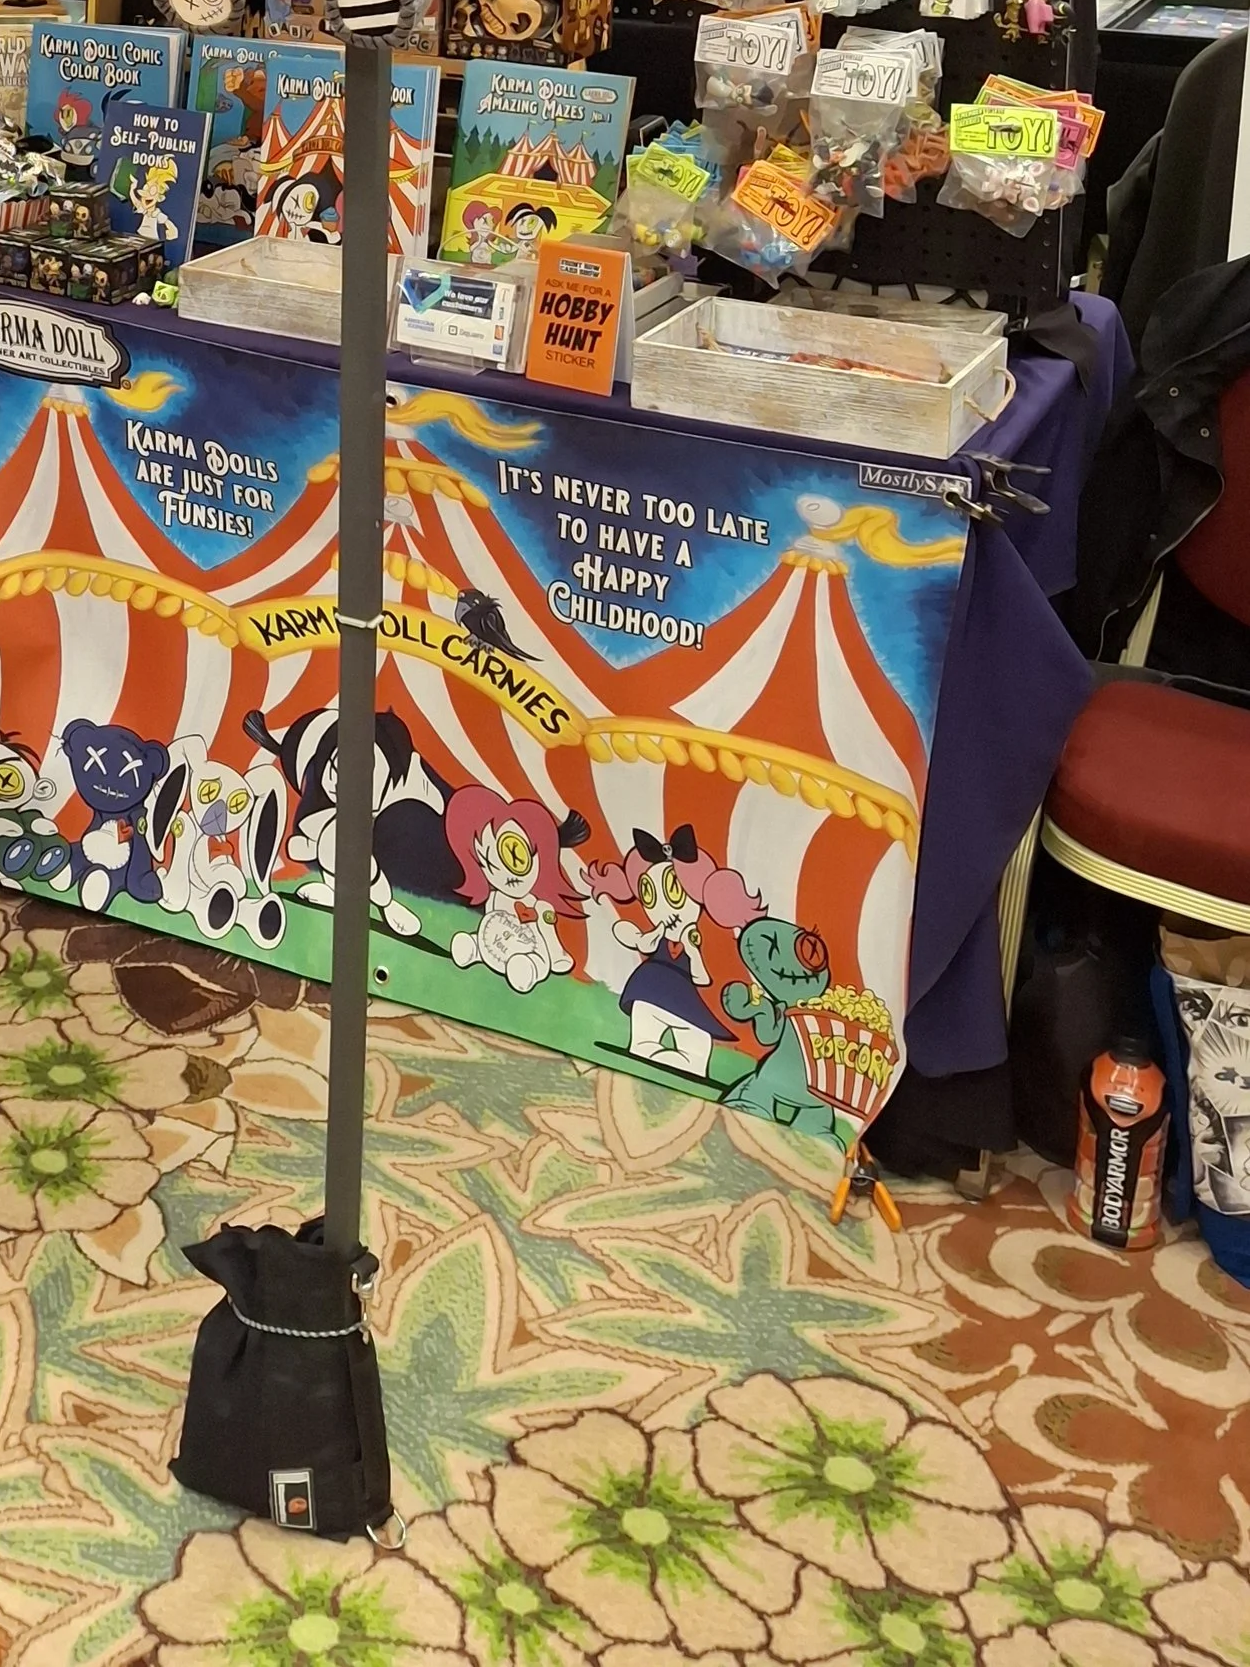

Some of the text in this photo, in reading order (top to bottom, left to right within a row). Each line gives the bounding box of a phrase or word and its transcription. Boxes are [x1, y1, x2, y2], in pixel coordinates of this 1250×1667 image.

[269, 23, 312, 38] BABY
[40, 34, 162, 66] KARMA DOLL COMIC
[202, 44, 265, 64] KARMA DOLL
[726, 31, 787, 70] TOY!
[59, 58, 141, 87] COLOR BOOK
[277, 74, 341, 101] KARMA DOLL
[491, 74, 533, 95] KARMA
[538, 78, 576, 100] DOLL
[842, 61, 903, 100] TOY!
[133, 114, 179, 132] HOW TO
[477, 93, 538, 115] AMAZING
[541, 99, 585, 120] MAZES
[110, 125, 196, 154] SELF-PUBLISH
[983, 115, 1051, 153] TOY!
[132, 151, 169, 169] BOOKS
[761, 185, 824, 245] TOY!
[546, 278, 612, 298] ASK ME FOR A
[539, 292, 614, 326] HOBBY
[51, 323, 105, 363] DOLL
[545, 322, 602, 353] HUNT
[18, 351, 37, 362] ART
[40, 355, 106, 376] COLLECTIBLES
[545, 350, 596, 369] STICKER
[126, 419, 278, 482] KARMA DOLLS
[136, 459, 274, 512] ARE JUST FOR
[498, 460, 770, 545] IT'S NEVER TOO LATE
[158, 490, 254, 538] FUNSIES!
[557, 513, 693, 568] TO HAVE A
[572, 553, 670, 602] HAPPY
[547, 581, 705, 650] CHILDHOOD!
[441, 633, 571, 735] CARNIES
[809, 1033, 894, 1090] POPCORN
[1102, 1128, 1129, 1230] BODYARMOR
